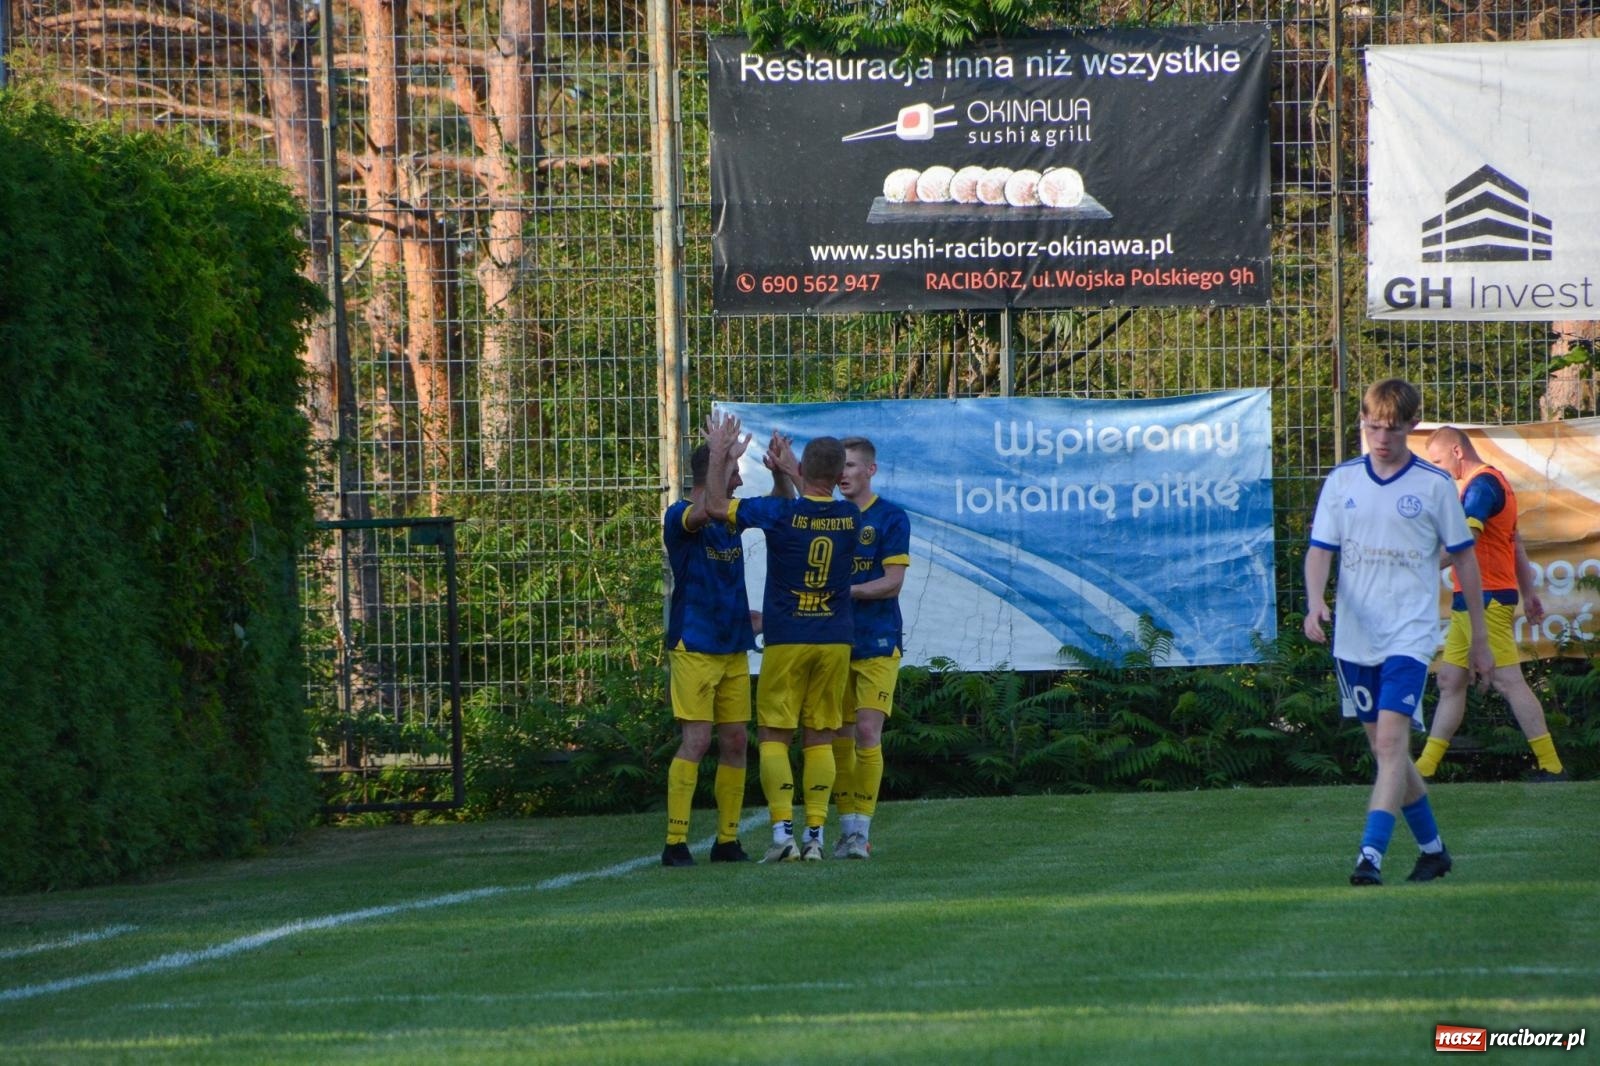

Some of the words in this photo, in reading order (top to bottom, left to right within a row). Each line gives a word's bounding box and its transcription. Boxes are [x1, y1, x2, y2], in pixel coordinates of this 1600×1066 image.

[739, 53, 934, 87] Restauracja
[946, 53, 1013, 79] inna
[1026, 48, 1073, 78] niż
[1082, 44, 1241, 81] wszystkie
[967, 98, 1091, 124] OKINAWA
[810, 233, 1174, 261] www.sushi-raciborz-okinawa.pl
[761, 275, 798, 294] 690
[803, 274, 839, 293] 562
[844, 273, 881, 292] 947
[925, 267, 1028, 290] RACIBÓRZ,
[1131, 267, 1224, 290] Polskiego
[1230, 267, 1255, 286] 9h
[1383, 276, 1453, 310] GH
[1470, 276, 1594, 309] Invest
[993, 418, 1239, 465] Wspieramy
[955, 477, 1117, 520] lokalną
[1131, 471, 1241, 518] piłkę
[804, 535, 834, 589] 9
